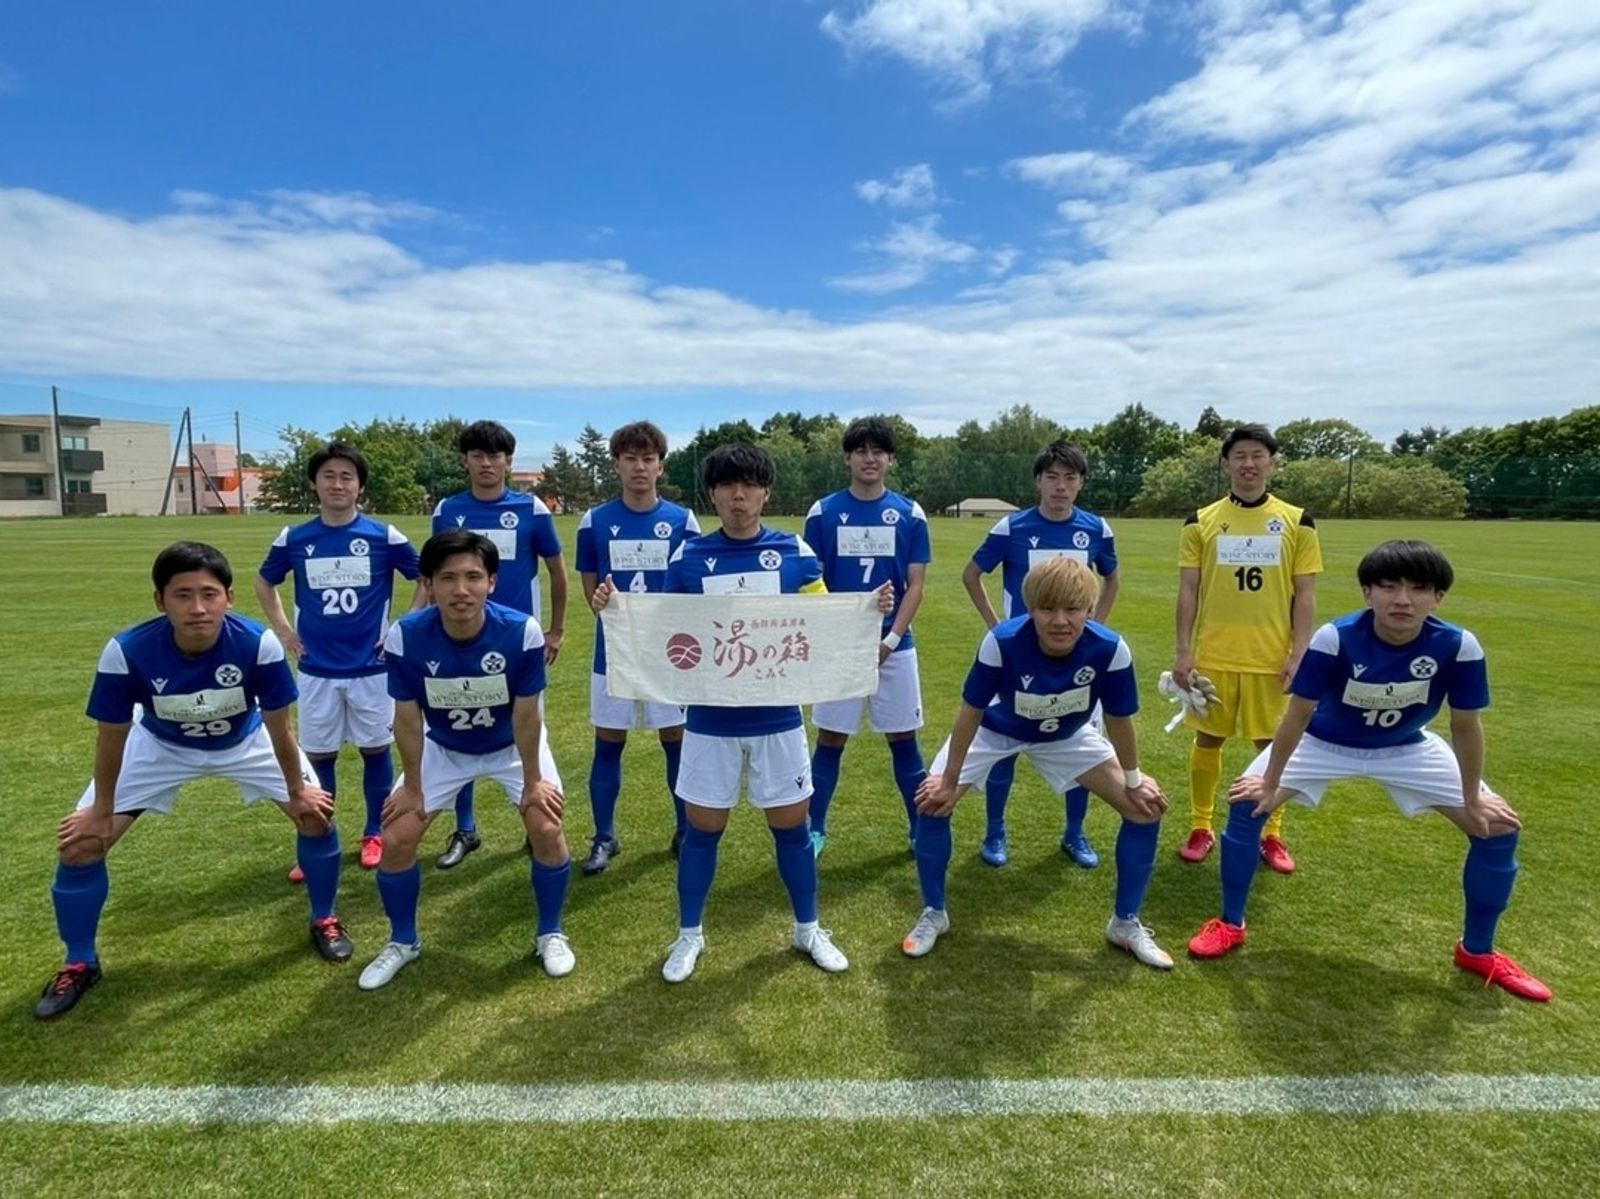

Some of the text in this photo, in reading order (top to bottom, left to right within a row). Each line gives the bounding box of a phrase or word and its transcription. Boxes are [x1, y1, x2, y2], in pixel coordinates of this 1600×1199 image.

[859, 557, 875, 583] 7
[1234, 566, 1263, 591] 16
[629, 571, 647, 593] 4
[321, 588, 358, 615] 20
[180, 719, 232, 737] 29
[448, 708, 495, 730] 24
[1039, 718, 1059, 733] 6
[1362, 709, 1402, 728] 10
